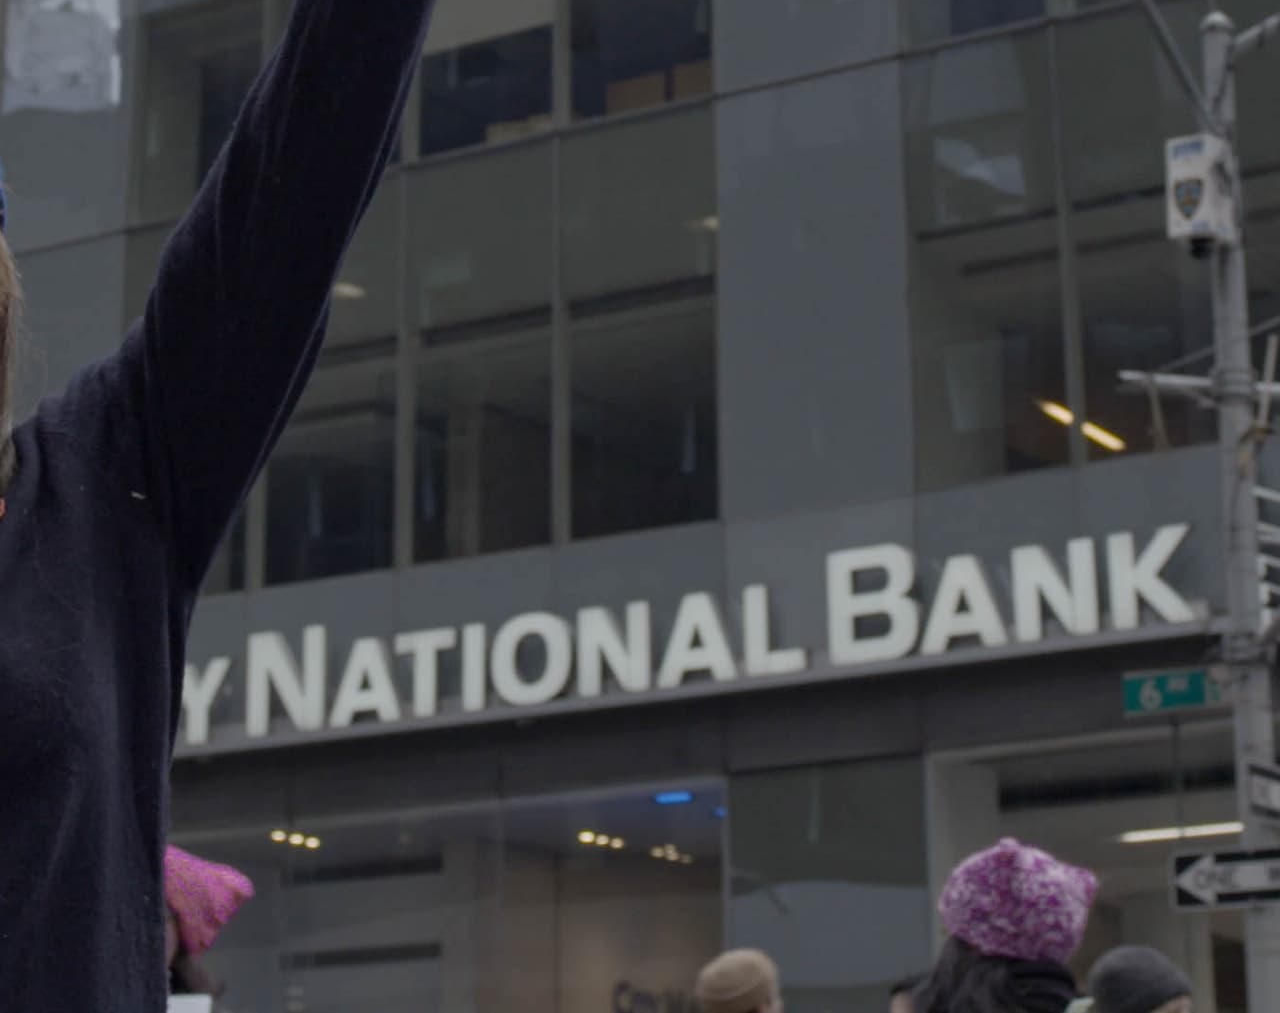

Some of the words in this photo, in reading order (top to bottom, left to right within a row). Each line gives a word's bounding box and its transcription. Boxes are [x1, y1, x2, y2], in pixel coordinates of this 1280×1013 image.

[245, 583, 808, 737] NATIONAL
[825, 522, 1200, 667] BANK
[1139, 678, 1163, 710] 6
